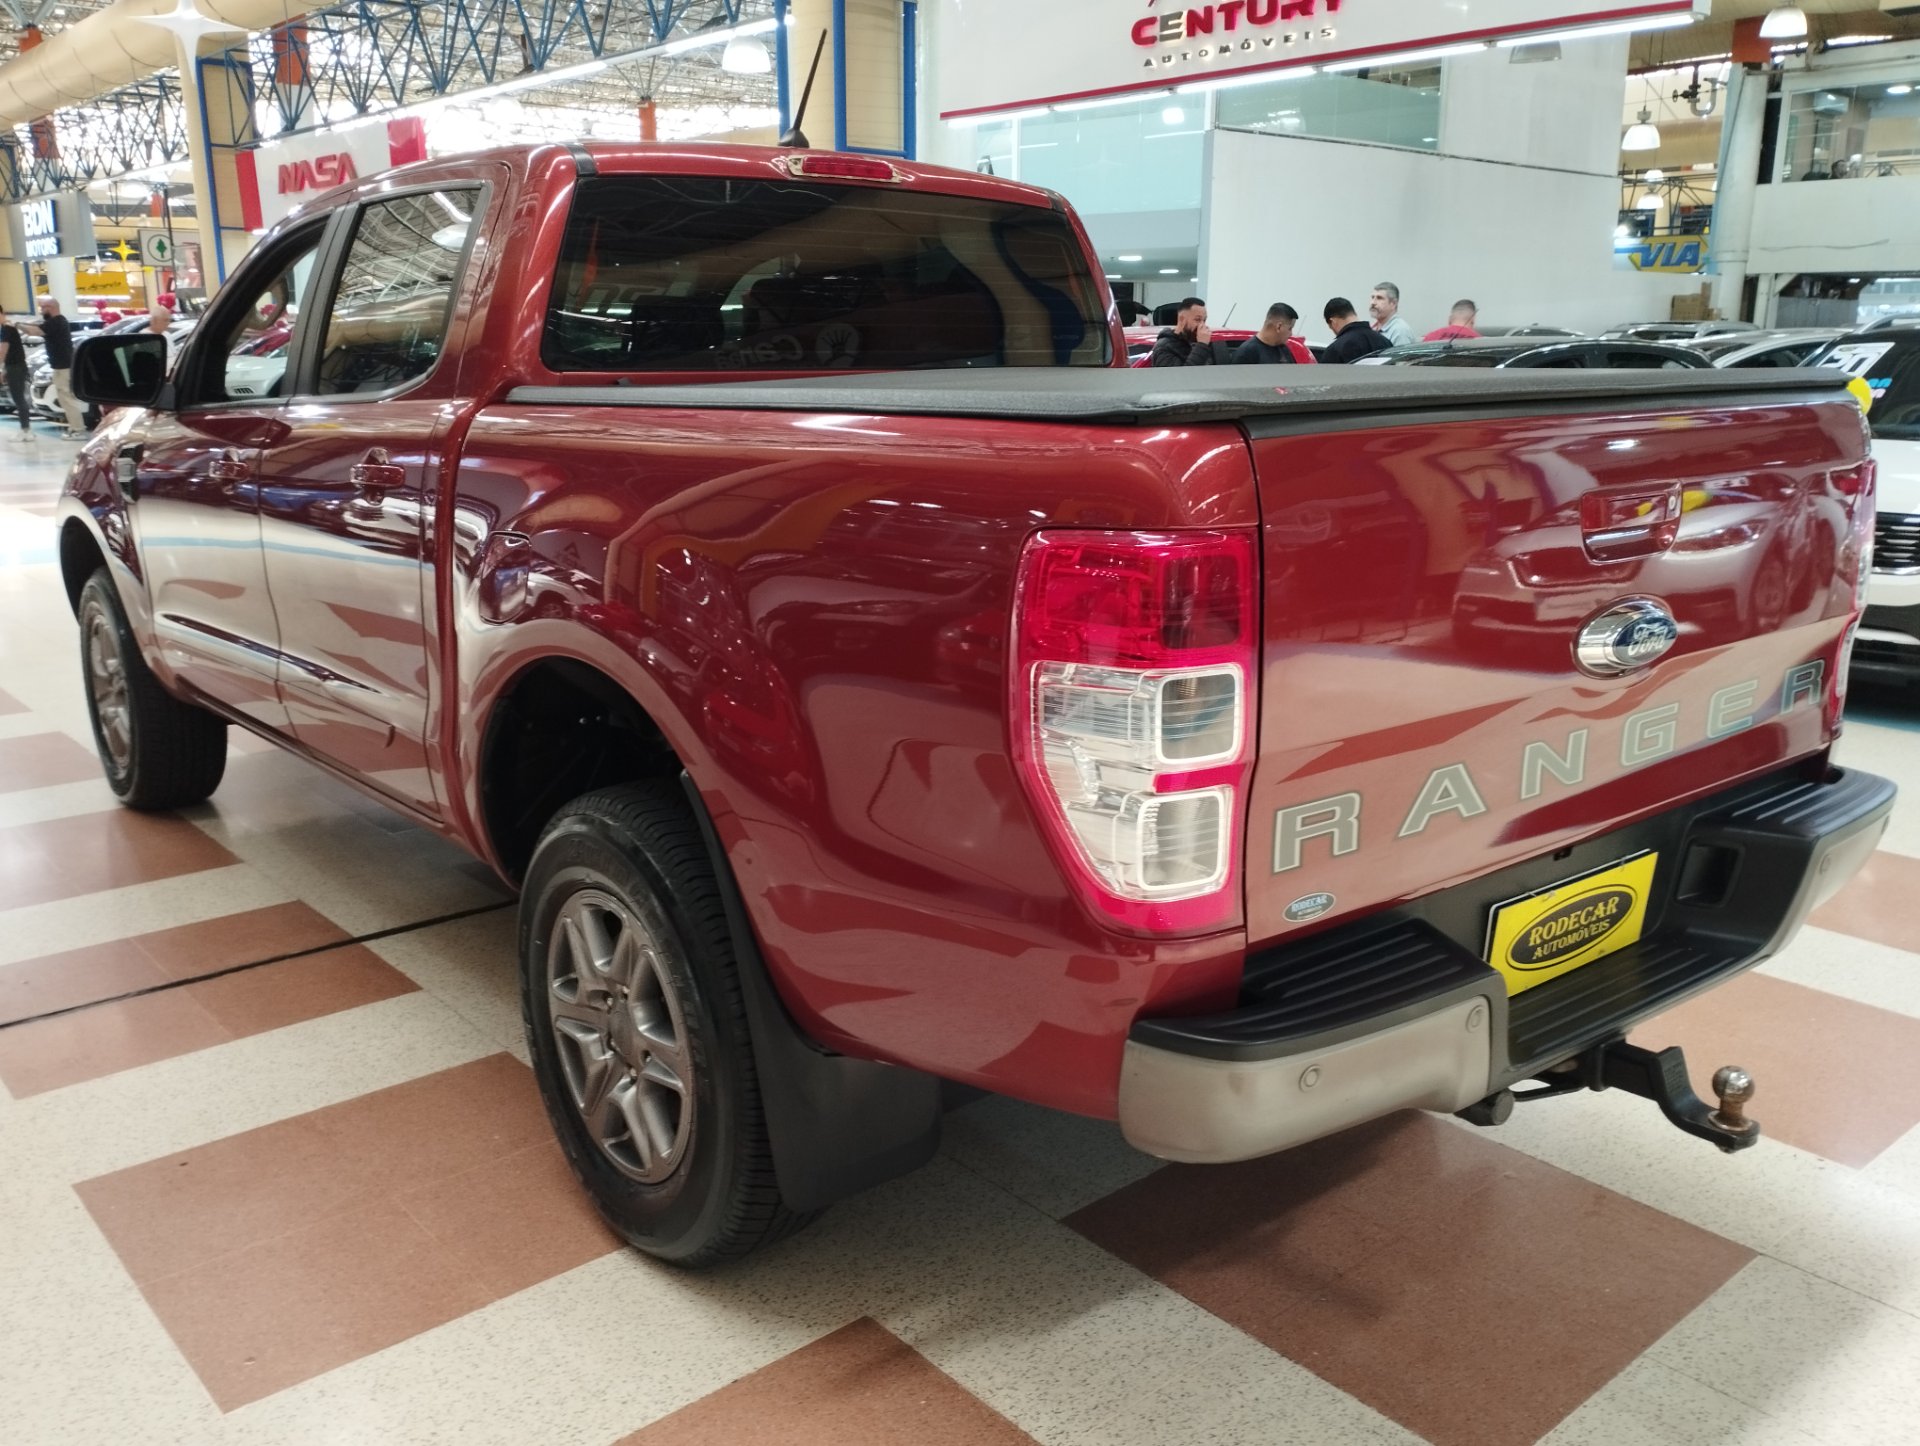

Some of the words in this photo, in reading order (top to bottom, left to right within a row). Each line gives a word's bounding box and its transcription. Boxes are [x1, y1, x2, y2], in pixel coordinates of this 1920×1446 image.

[1143, 27, 1336, 68] AUTOMÓVEIS
[277, 152, 358, 195] NASA
[25, 237, 59, 258] MOTORS
[1631, 241, 1701, 268] VIA
[1627, 621, 1670, 657] Ford
[1272, 659, 1826, 875] RANGER
[1528, 896, 1620, 948] RODECAR
[1531, 918, 1611, 961] AUTOMÓVEIS
